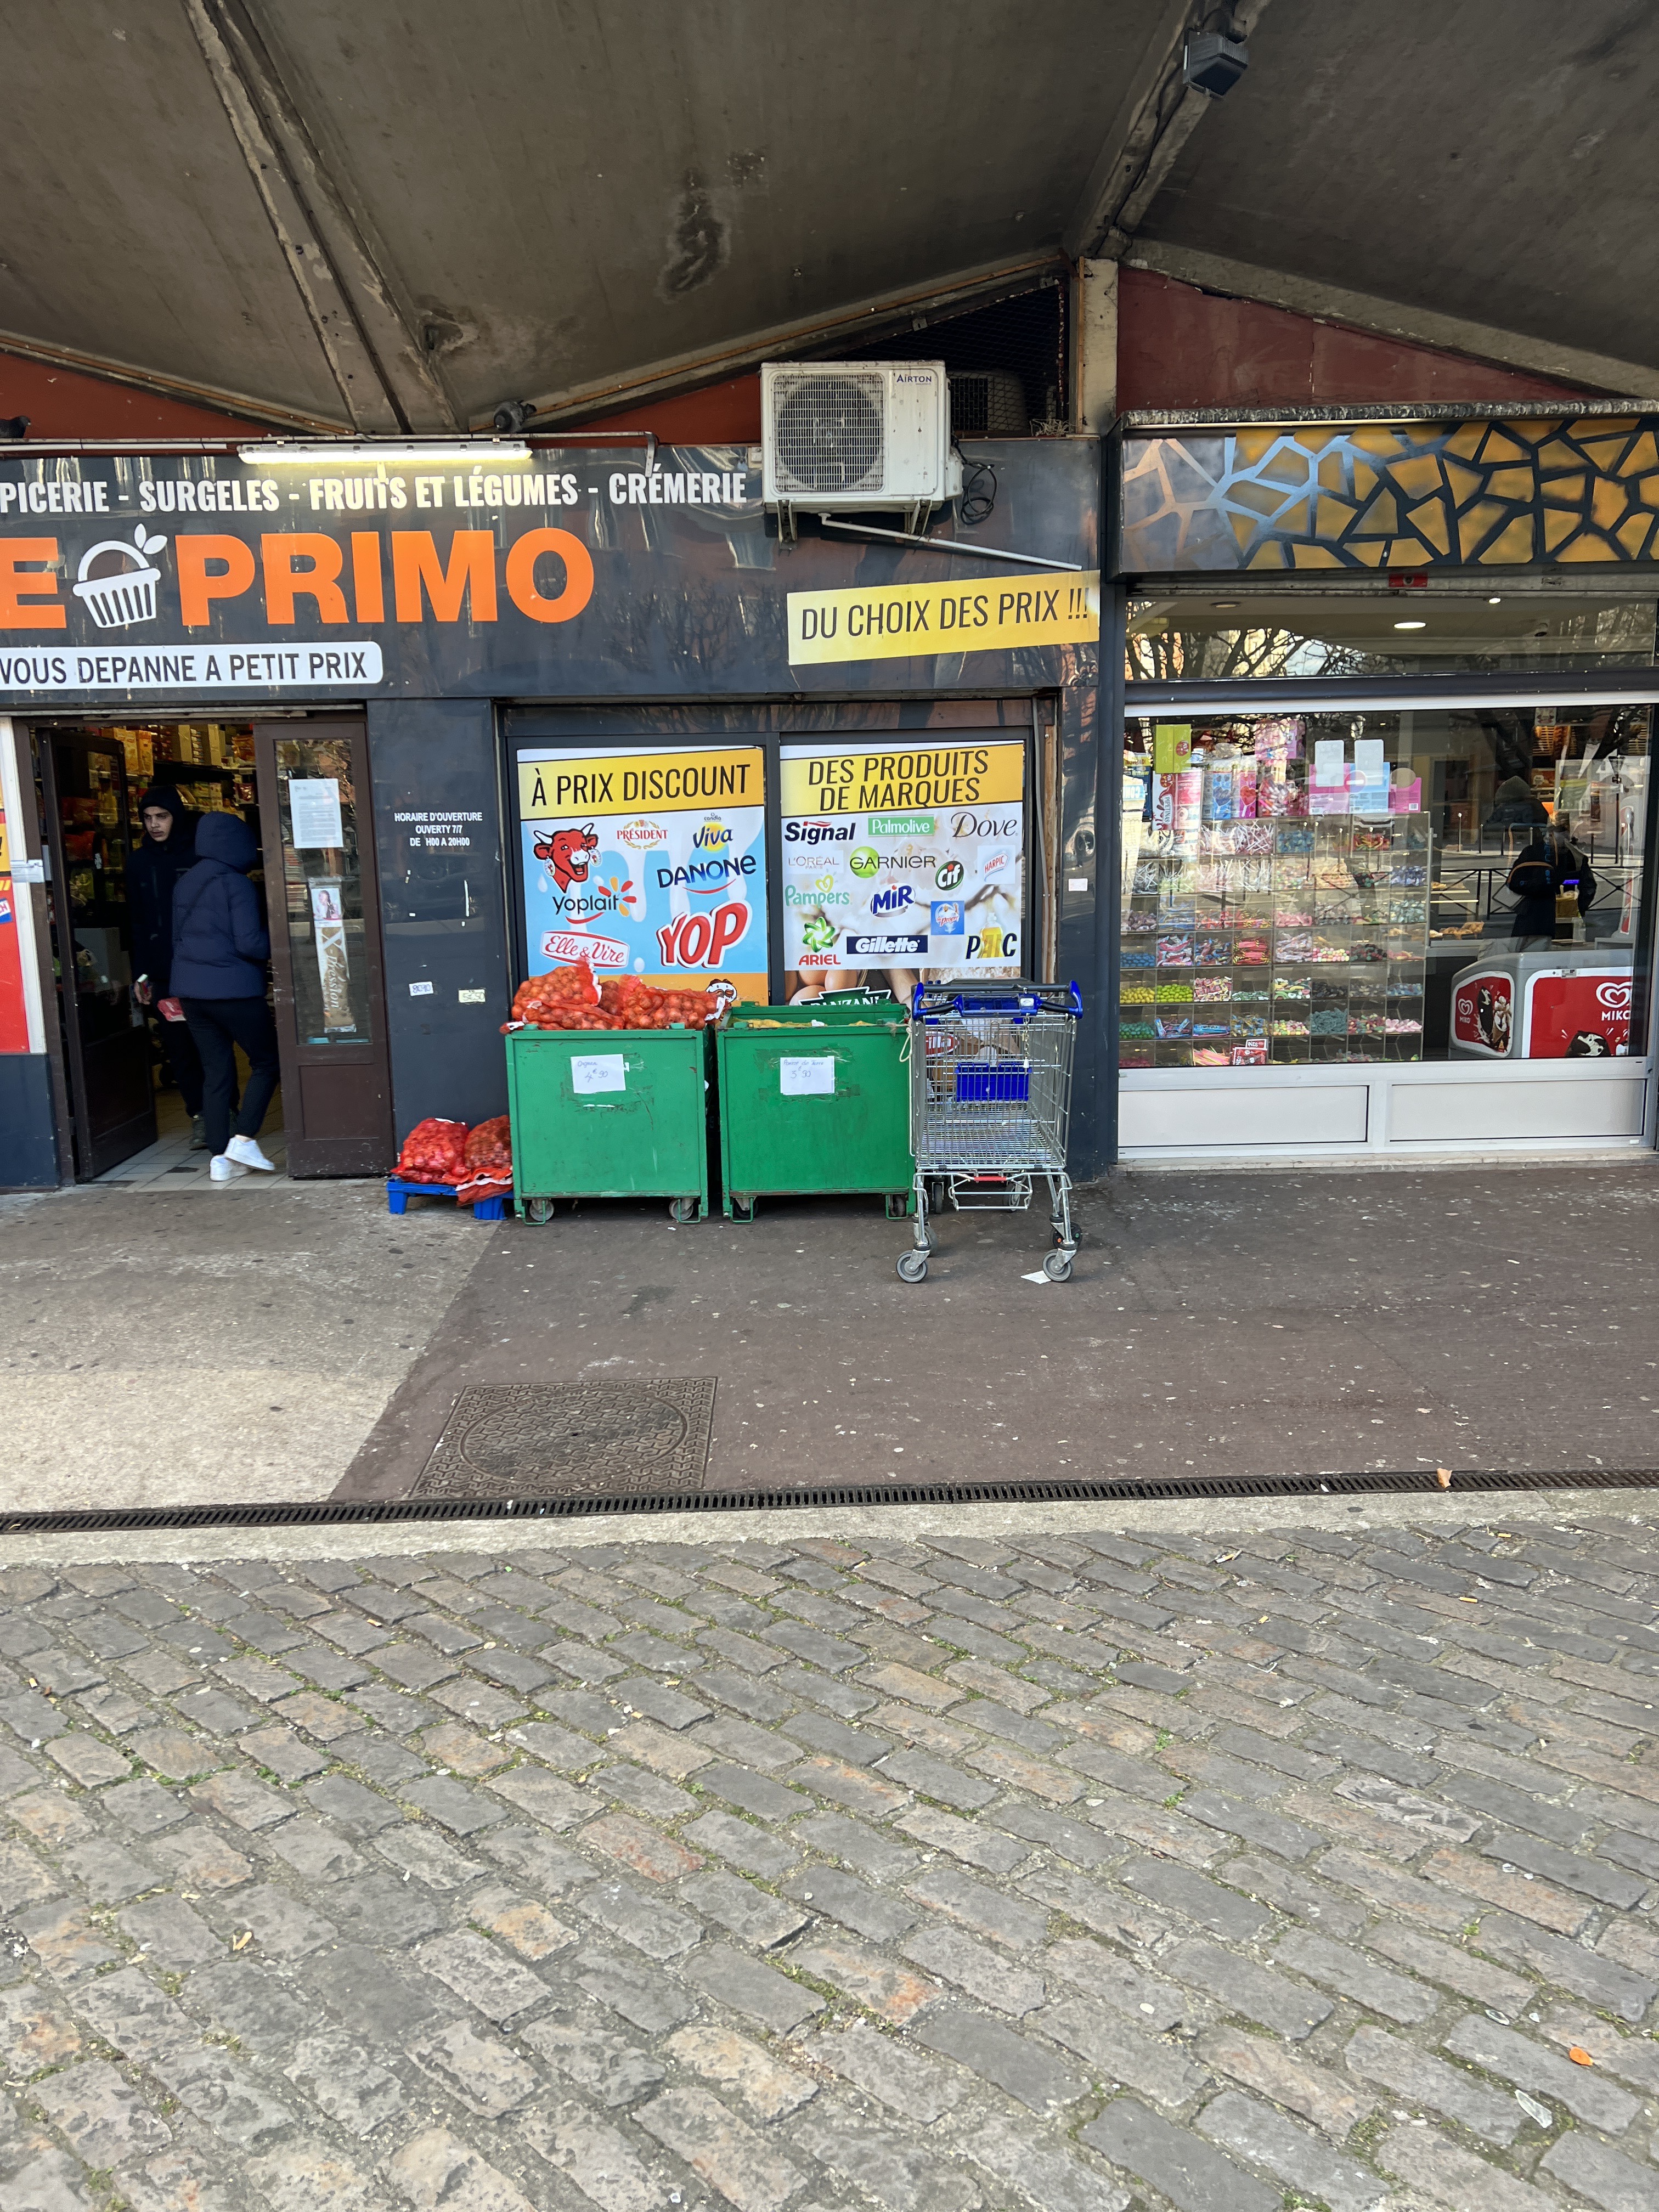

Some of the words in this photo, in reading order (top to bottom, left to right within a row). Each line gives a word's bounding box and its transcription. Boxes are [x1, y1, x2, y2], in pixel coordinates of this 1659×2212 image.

[140, 479, 278, 512] SURGELES
[309, 477, 407, 510] FRUITS
[415, 476, 445, 507] ET
[454, 466, 578, 507] LÉGUMES
[609, 463, 747, 504] CRÉMERIE
[175, 527, 594, 627] PRIMO
[802, 606, 837, 640] DU
[848, 599, 930, 636] CHOIX
[940, 595, 988, 629] DES
[998, 589, 1059, 625] PRIX
[0, 658, 66, 684] VOUS
[80, 656, 196, 683] DEPANNE
[206, 655, 221, 681] A
[230, 653, 300, 680] PETIT
[309, 652, 368, 679] PRIX
[809, 759, 854, 786] DES
[864, 749, 989, 782] PRODUITS
[532, 769, 546, 806] À
[557, 773, 613, 805] PRIX
[623, 764, 751, 801] DISCOUNT
[820, 786, 850, 812] DE
[859, 777, 980, 808] MARQUES
[394, 812, 428, 822] HORAIRE
[430, 812, 482, 822] D'OUVERTURE
[872, 819, 930, 834] Palmolive
[951, 812, 1017, 838] Dove
[410, 837, 421, 847] DE
[441, 837, 447, 846] A
[448, 837, 470, 846] 20H00
[617, 828, 668, 842] PRÉSIDENT
[693, 826, 733, 848] Viva
[785, 821, 856, 845] Signal
[788, 856, 839, 866] L'ORÉAL
[984, 855, 1005, 873] HARPIC
[937, 864, 961, 888] Cif
[552, 895, 619, 915] Yoplait
[785, 884, 850, 909] Pampers
[657, 902, 749, 967] YOP
[855, 936, 918, 953] Gillette
[545, 935, 579, 956] Elle
[579, 946, 591, 958] &
[592, 942, 624, 963] Vire
[798, 955, 842, 966] ARIEL
